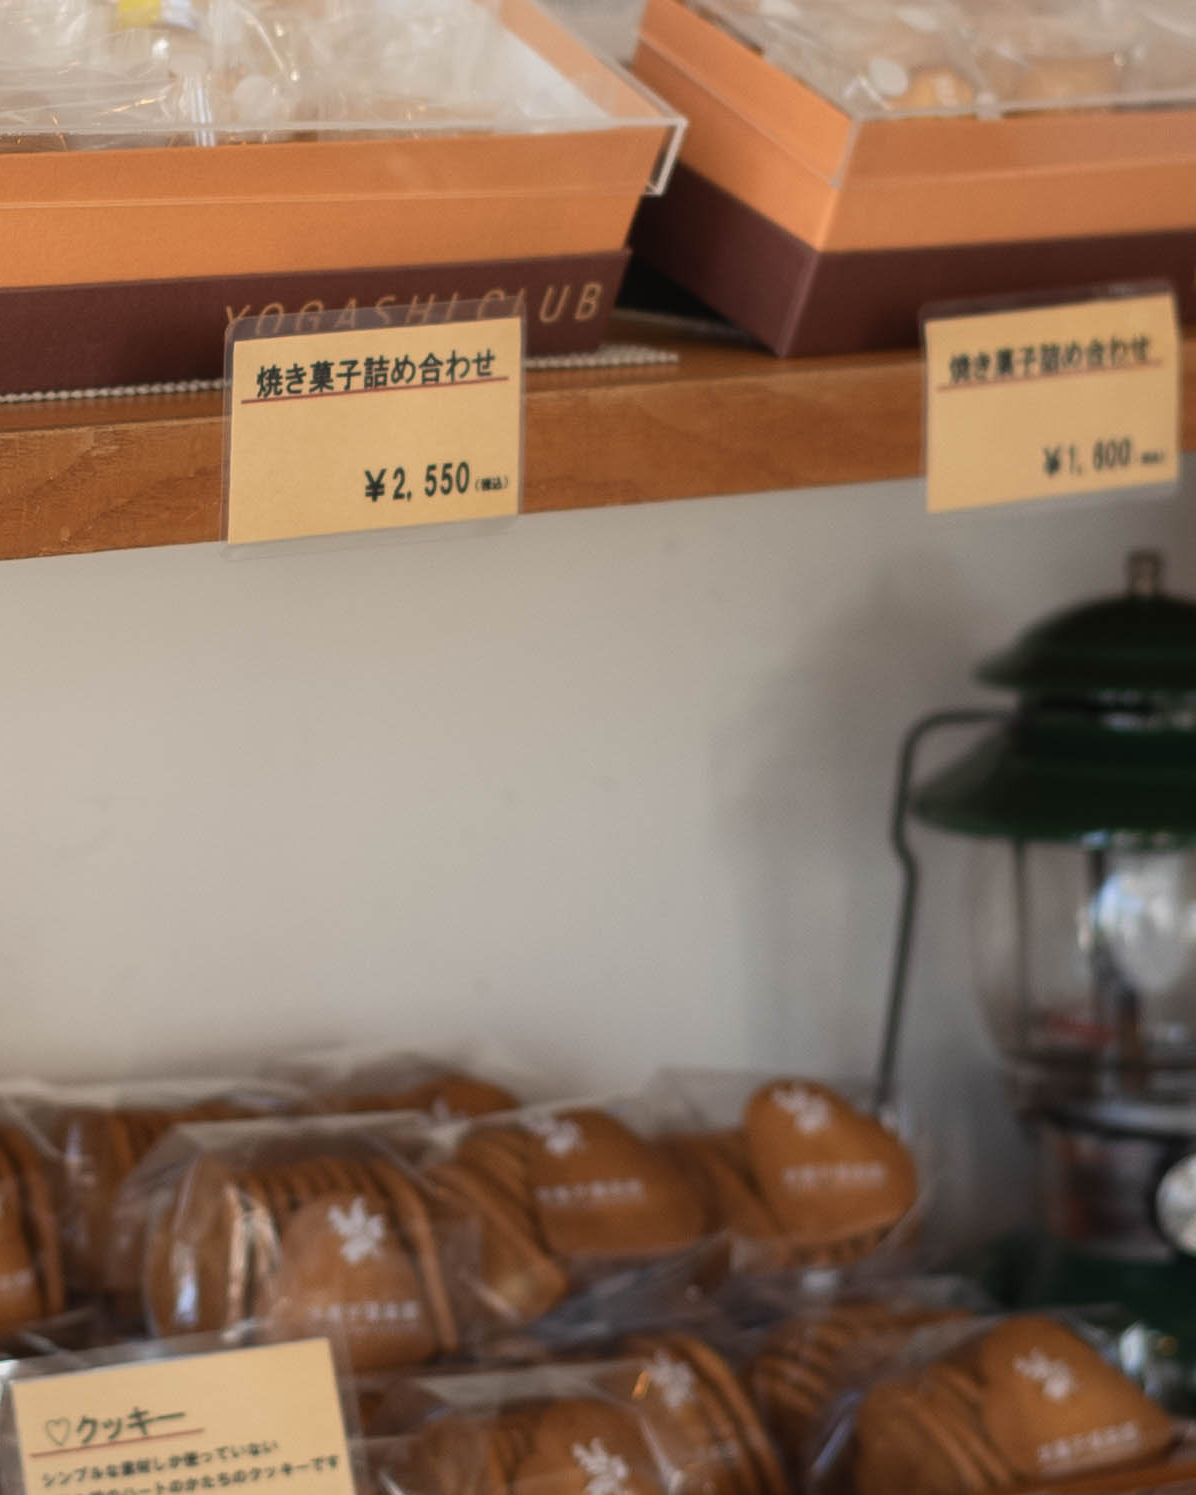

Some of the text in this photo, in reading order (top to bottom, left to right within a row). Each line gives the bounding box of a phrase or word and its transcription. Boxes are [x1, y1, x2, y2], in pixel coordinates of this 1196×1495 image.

[256, 349, 496, 400] 焼き菓子詰め合わせ
[364, 462, 471, 502] ¥2,550
